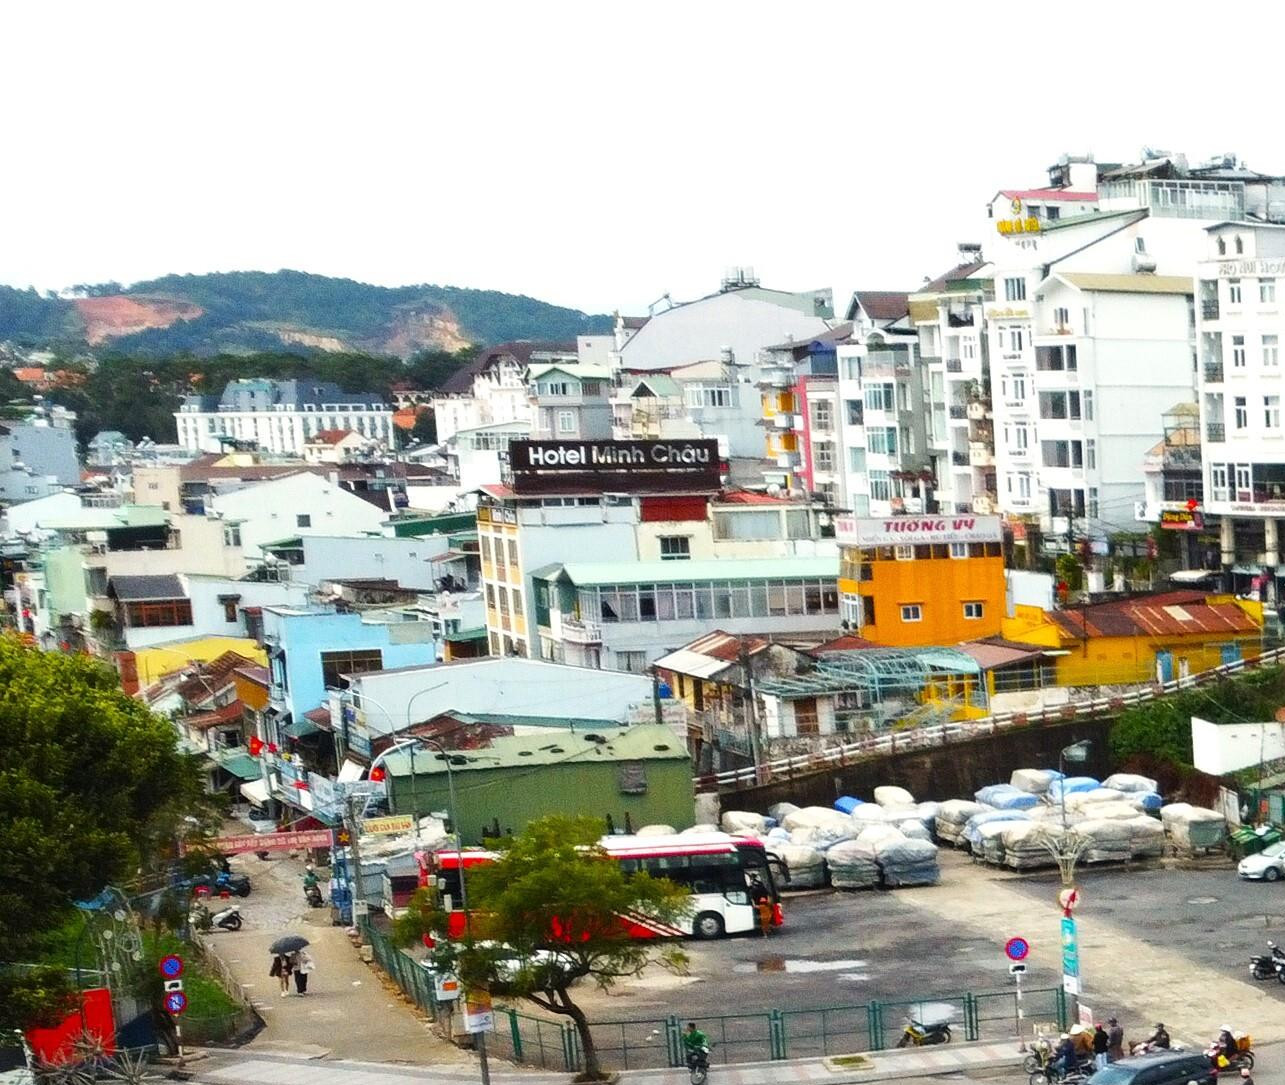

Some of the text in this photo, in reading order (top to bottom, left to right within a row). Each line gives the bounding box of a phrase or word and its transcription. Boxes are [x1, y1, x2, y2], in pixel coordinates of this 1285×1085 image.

[528, 443, 710, 465] Hotel Minh Châu
